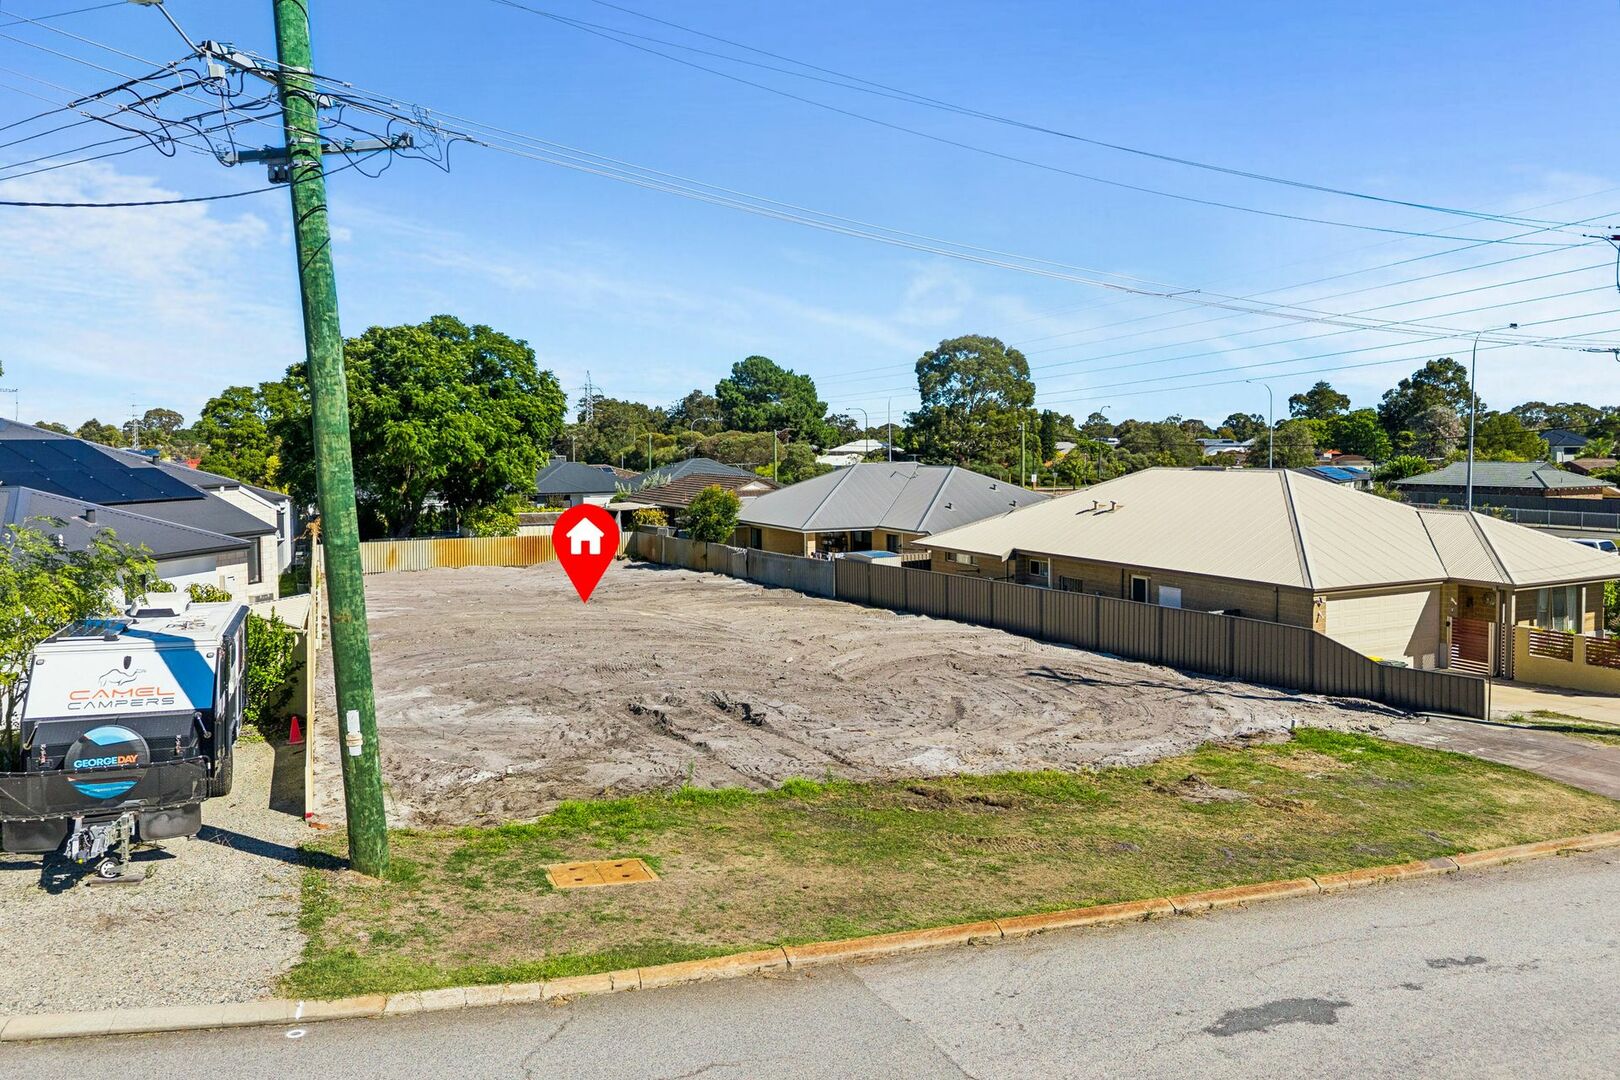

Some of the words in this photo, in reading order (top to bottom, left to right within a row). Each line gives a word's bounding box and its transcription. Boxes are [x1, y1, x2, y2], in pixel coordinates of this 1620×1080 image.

[70, 687, 175, 700] CAMEL
[67, 697, 175, 710] CAMPERS
[74, 755, 138, 768] GEORGEDAY
